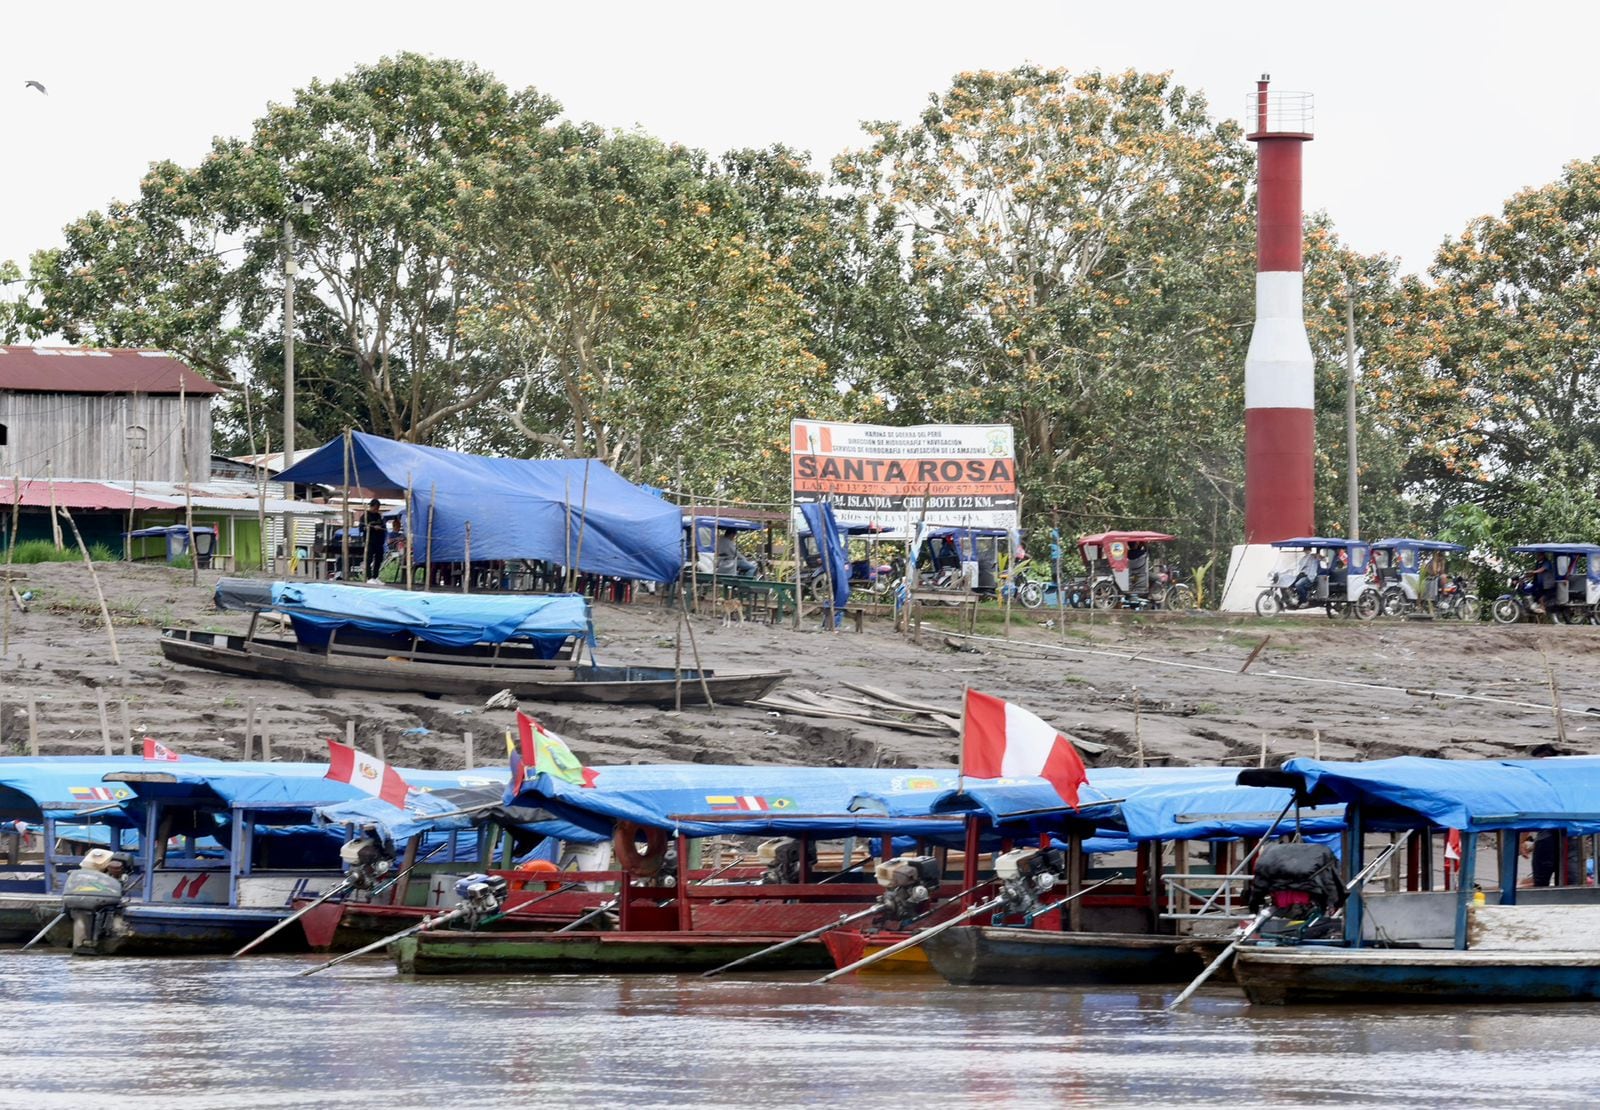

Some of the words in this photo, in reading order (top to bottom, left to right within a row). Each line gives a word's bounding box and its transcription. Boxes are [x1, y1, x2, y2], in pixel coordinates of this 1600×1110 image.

[798, 456, 906, 482] SANTA
[918, 460, 1010, 482] ROSA
[847, 496, 892, 508] ISLANDIA
[959, 497, 972, 507] 122
[975, 497, 994, 507] KM.
